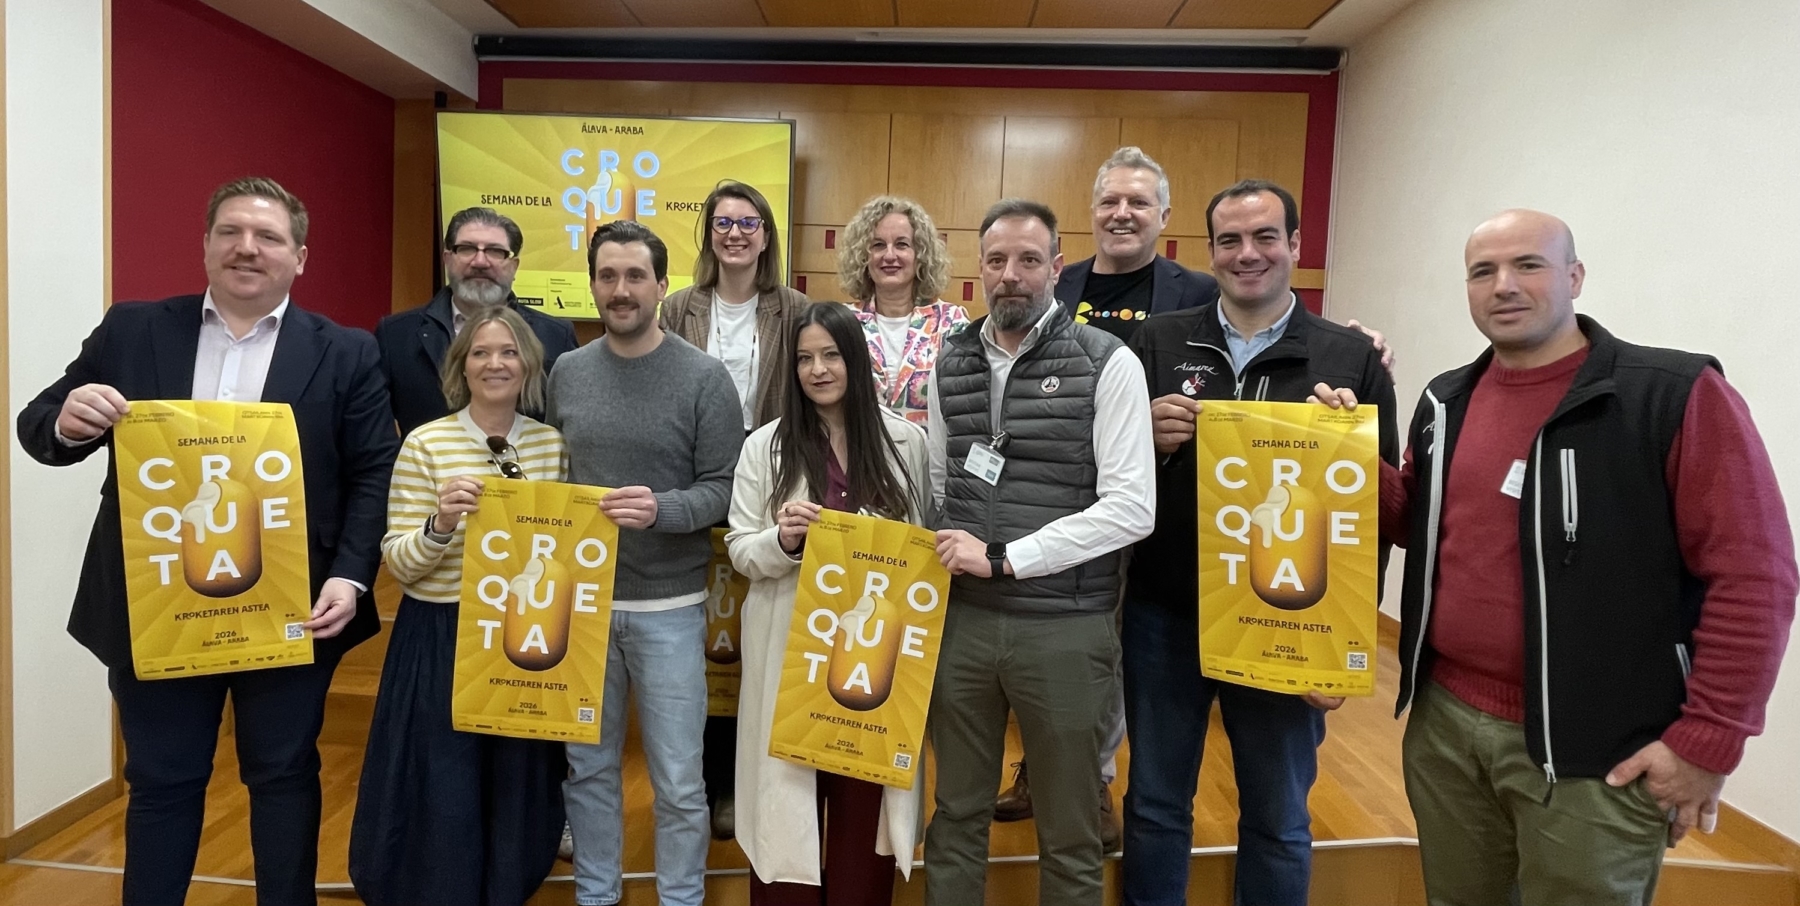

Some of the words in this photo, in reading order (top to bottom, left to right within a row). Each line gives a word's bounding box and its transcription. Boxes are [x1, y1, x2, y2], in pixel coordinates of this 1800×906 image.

[581, 122, 608, 134] ÁLAVA
[615, 125, 644, 136] ARABA
[481, 194, 523, 207] SEMANA
[525, 195, 541, 207] DE
[542, 195, 553, 207] LA
[177, 436, 219, 447] SEMANA
[221, 435, 235, 445] DE
[236, 435, 247, 444] LA
[1251, 439, 1291, 449] SEMANA
[1293, 440, 1307, 449] DE
[1308, 440, 1319, 449] LA
[516, 515, 549, 526] SEMANA
[551, 518, 562, 527] DE
[564, 519, 573, 527] LA
[852, 550, 885, 564] SEMANA
[886, 556, 898, 566] DE
[898, 558, 908, 568] LA
[174, 606, 239, 622] KROKETAREN
[241, 603, 270, 614] ASTEA
[1238, 616, 1300, 631] KROKETAREN
[1302, 623, 1332, 634] ASTEA
[214, 630, 237, 640] 2026
[1274, 644, 1297, 654] 2026
[489, 677, 542, 690] KROKETAREN
[544, 682, 568, 692] ASTEA
[809, 711, 862, 729] KROKETAREN
[863, 723, 888, 735] ASTEA
[836, 739, 855, 748] 2026
